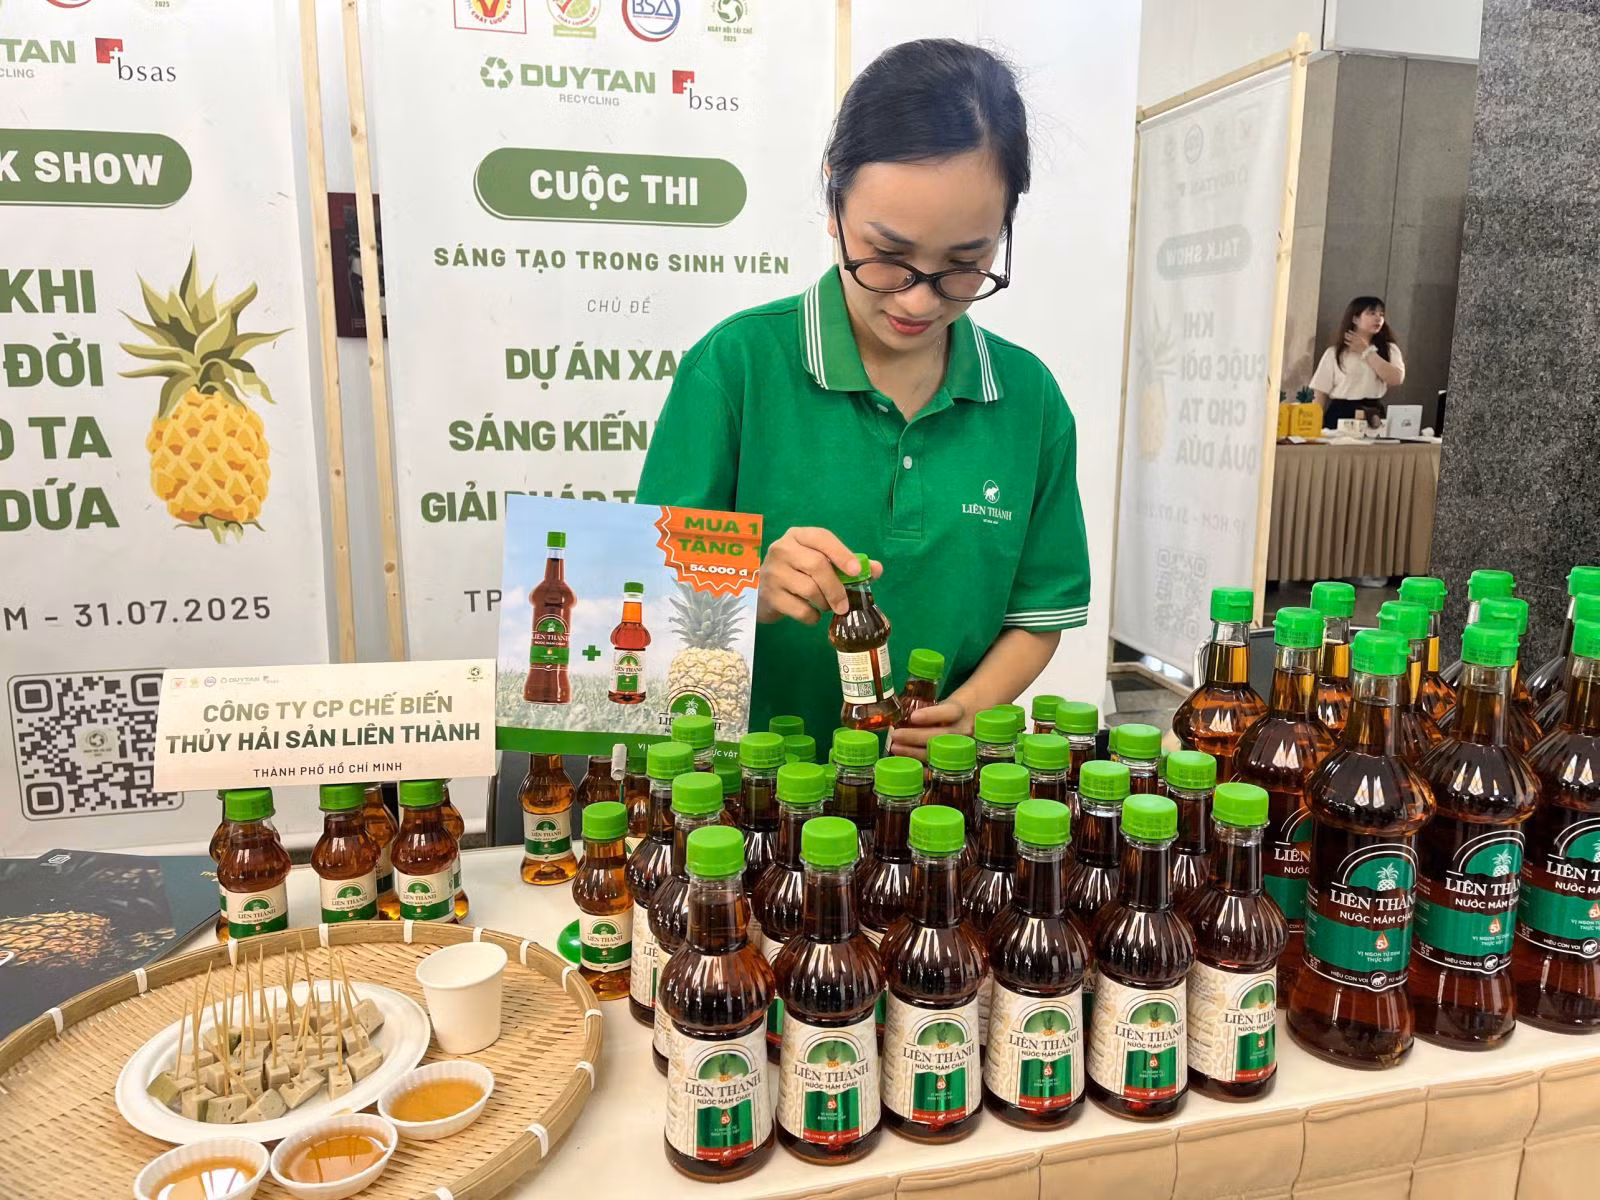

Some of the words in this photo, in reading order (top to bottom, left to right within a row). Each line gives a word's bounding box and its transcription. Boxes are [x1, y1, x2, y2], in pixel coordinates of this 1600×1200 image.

[117, 57, 177, 82] bsas
[520, 63, 656, 94] DUYTAN
[559, 93, 620, 107] RECYCLING
[688, 87, 740, 112] bsas
[33, 150, 163, 187] SHOW
[529, 164, 630, 211] CUỘC
[640, 174, 699, 206] THI
[433, 243, 506, 267] SÁNG
[515, 249, 567, 274] TẠO
[575, 250, 660, 272] TRONG
[668, 253, 725, 273] SINH
[734, 251, 790, 275] VIÊN
[0, 268, 97, 314] KHI
[587, 296, 622, 313] CHỦ
[629, 296, 652, 314] ĐỀ
[2, 332, 104, 388] ĐỜI
[504, 344, 561, 390] DỰ
[564, 341, 621, 381] ÁN
[627, 349, 688, 381] XA
[28, 415, 113, 460] TA
[448, 412, 557, 452] SÁNG
[563, 409, 648, 452] KIẾN
[0, 477, 121, 532] DỨA
[420, 480, 498, 522] GIẢI
[962, 503, 986, 516] LIÊN
[684, 515, 740, 535] MUA
[747, 521, 759, 536] 1
[677, 536, 745, 557] TẶNG
[752, 545, 762, 559] 1
[689, 563, 736, 576] 54.000
[464, 589, 503, 613] TP
[3, 606, 29, 632] M
[73, 596, 271, 628] 31.07.2025
[203, 700, 270, 724] CÔNG
[278, 700, 306, 719] TY
[313, 698, 344, 719] CP
[349, 692, 395, 717] CHẾ
[400, 690, 453, 715] BIẾN
[165, 728, 232, 754] THỦY
[237, 724, 279, 751] HẢI
[285, 723, 336, 750] SẢN
[342, 723, 395, 747] LIÊN
[400, 721, 481, 743] THÀNH
[723, 750, 739, 760] VẬT
[253, 763, 297, 779] THÀNH
[300, 762, 326, 776] PHỐ
[328, 761, 345, 775] HỒ
[348, 760, 370, 774] CHÍ
[372, 761, 403, 773] MINH
[1274, 847, 1311, 862] LIÊN
[1546, 859, 1589, 881] LIÊN
[1444, 876, 1488, 897] LIÊN
[1555, 880, 1586, 893] NƯỚC
[1330, 888, 1372, 910] LIÊN
[1375, 891, 1417, 911] THÀN
[1454, 897, 1487, 909] NƯỚC
[1339, 910, 1371, 924] NƯỚC
[1373, 915, 1396, 925] MẮM
[643, 946, 658, 958] LIÊ
[1330, 971, 1344, 979] HIỆU
[1225, 1012, 1255, 1025] LIÊN
[1255, 1007, 1277, 1021] THÀ
[1008, 1033, 1038, 1050] LIÊN
[1115, 1024, 1144, 1042] LIÊN
[903, 1046, 932, 1063] LIÊN
[794, 1064, 822, 1082] LIÊN
[685, 1081, 718, 1098] LIÊN
